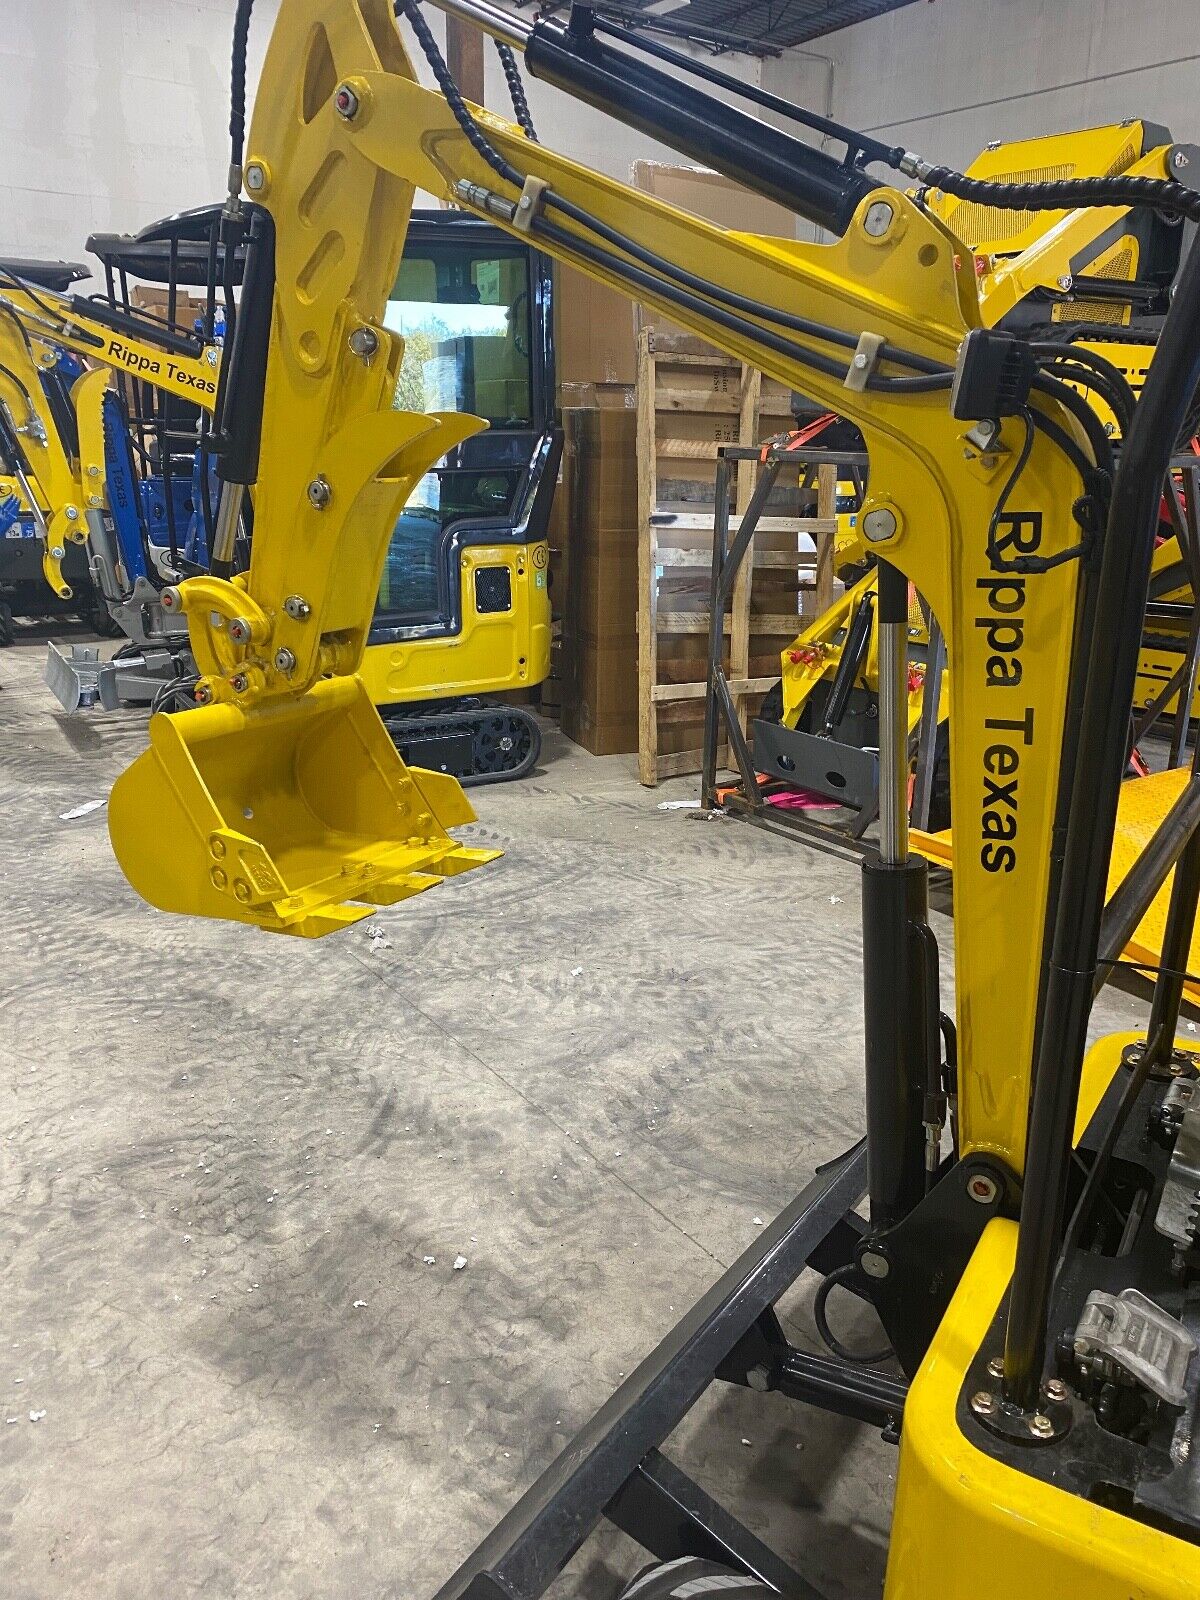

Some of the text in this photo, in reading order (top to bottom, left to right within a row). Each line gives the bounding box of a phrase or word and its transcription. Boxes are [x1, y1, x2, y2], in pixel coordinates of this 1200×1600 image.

[108, 341, 215, 394] Rippa Texas
[111, 466, 128, 508] Texas
[975, 511, 1042, 873] Rppa Texas
